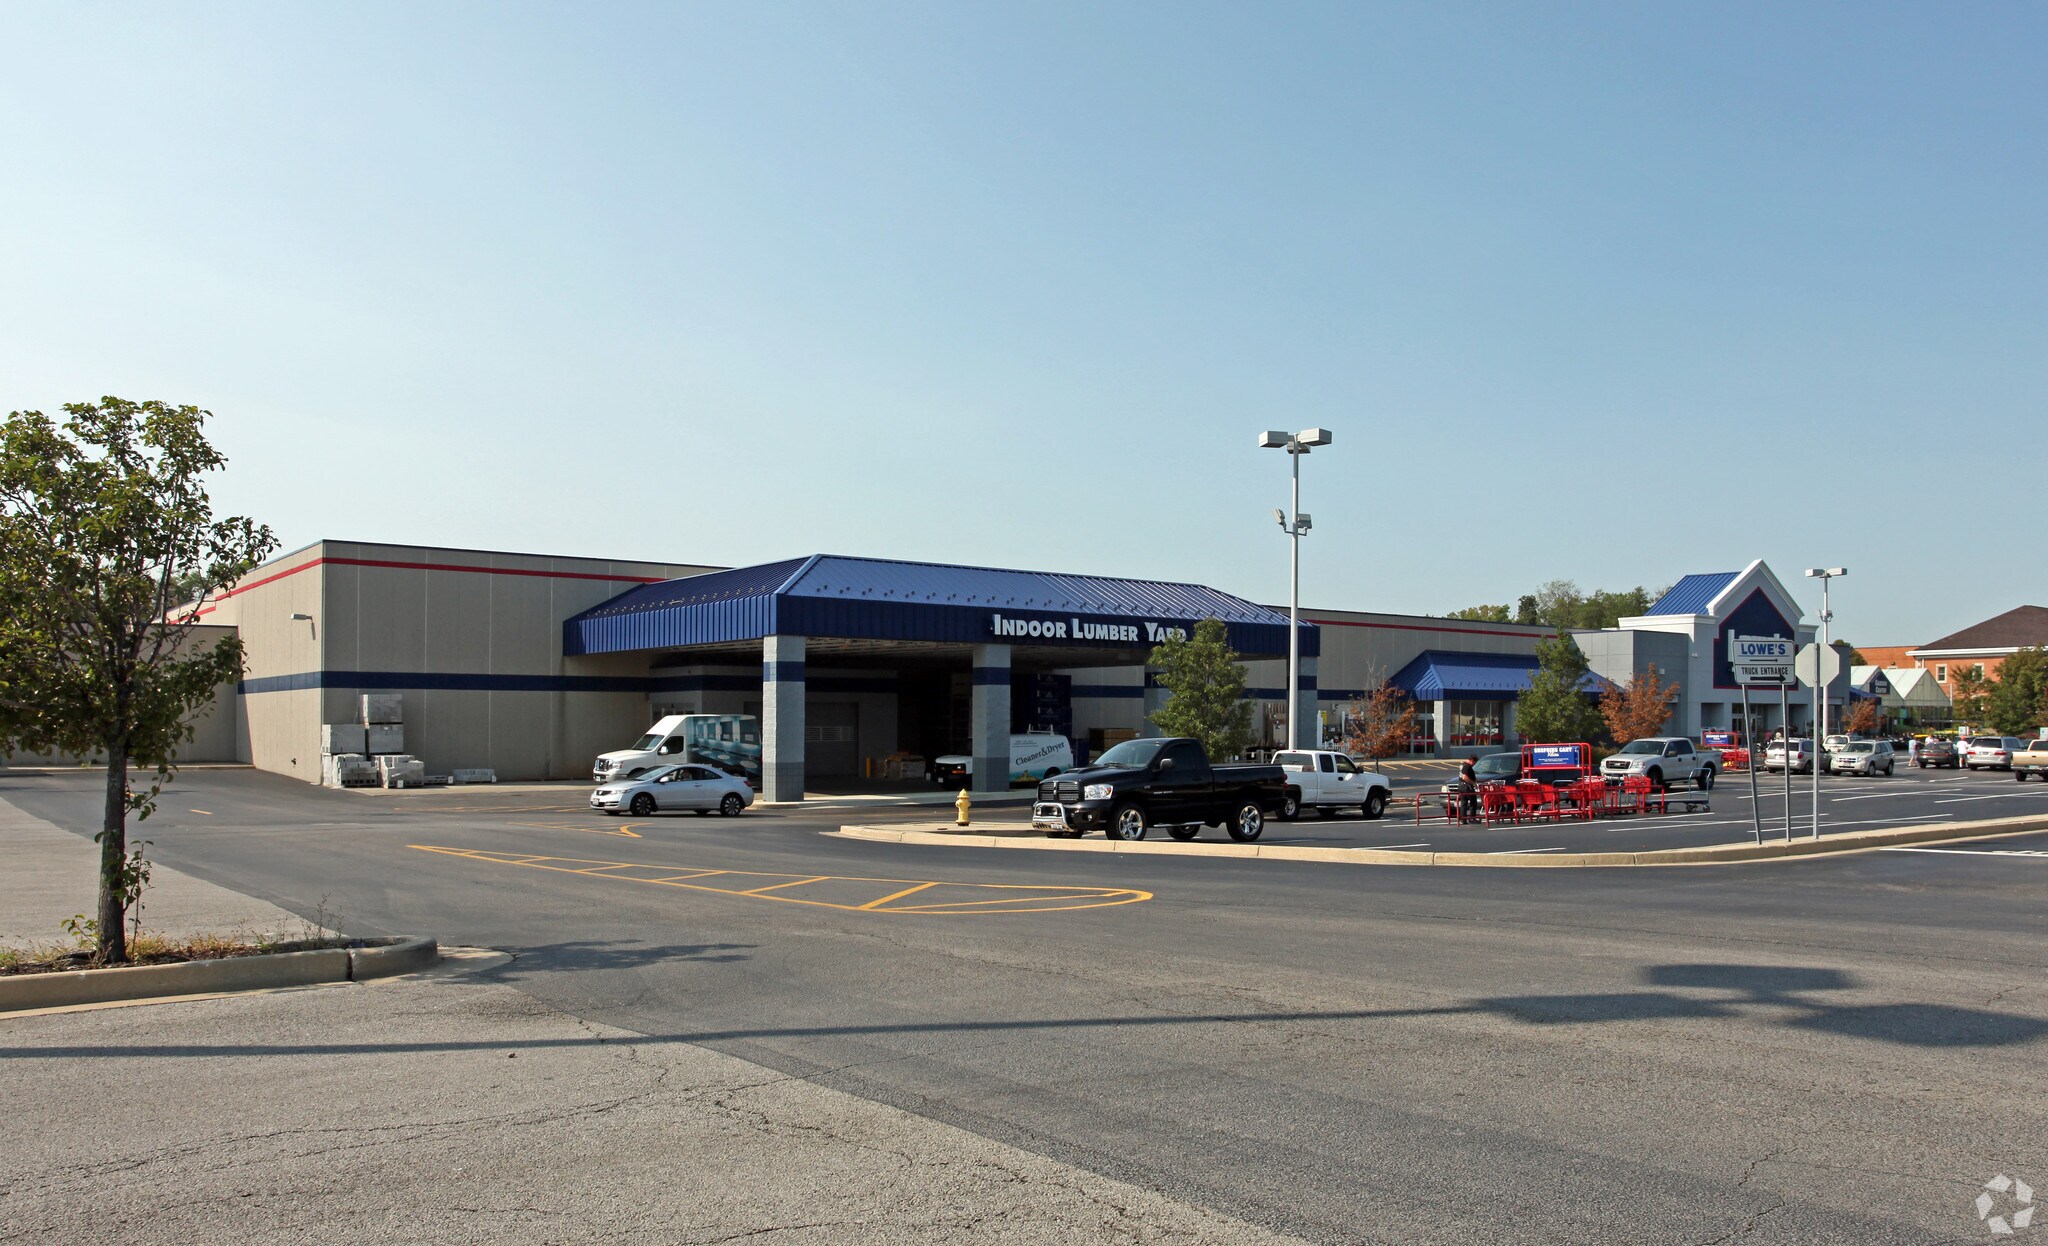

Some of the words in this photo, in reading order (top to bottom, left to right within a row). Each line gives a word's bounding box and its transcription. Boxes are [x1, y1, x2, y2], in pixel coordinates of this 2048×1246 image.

[993, 614, 1067, 638] INDOOR
[1072, 618, 1138, 642] LUMBER
[1741, 643, 1786, 655] LOWE'S
[1741, 667, 1759, 675] TRUCK
[1760, 667, 1789, 675] ENTRANCE
